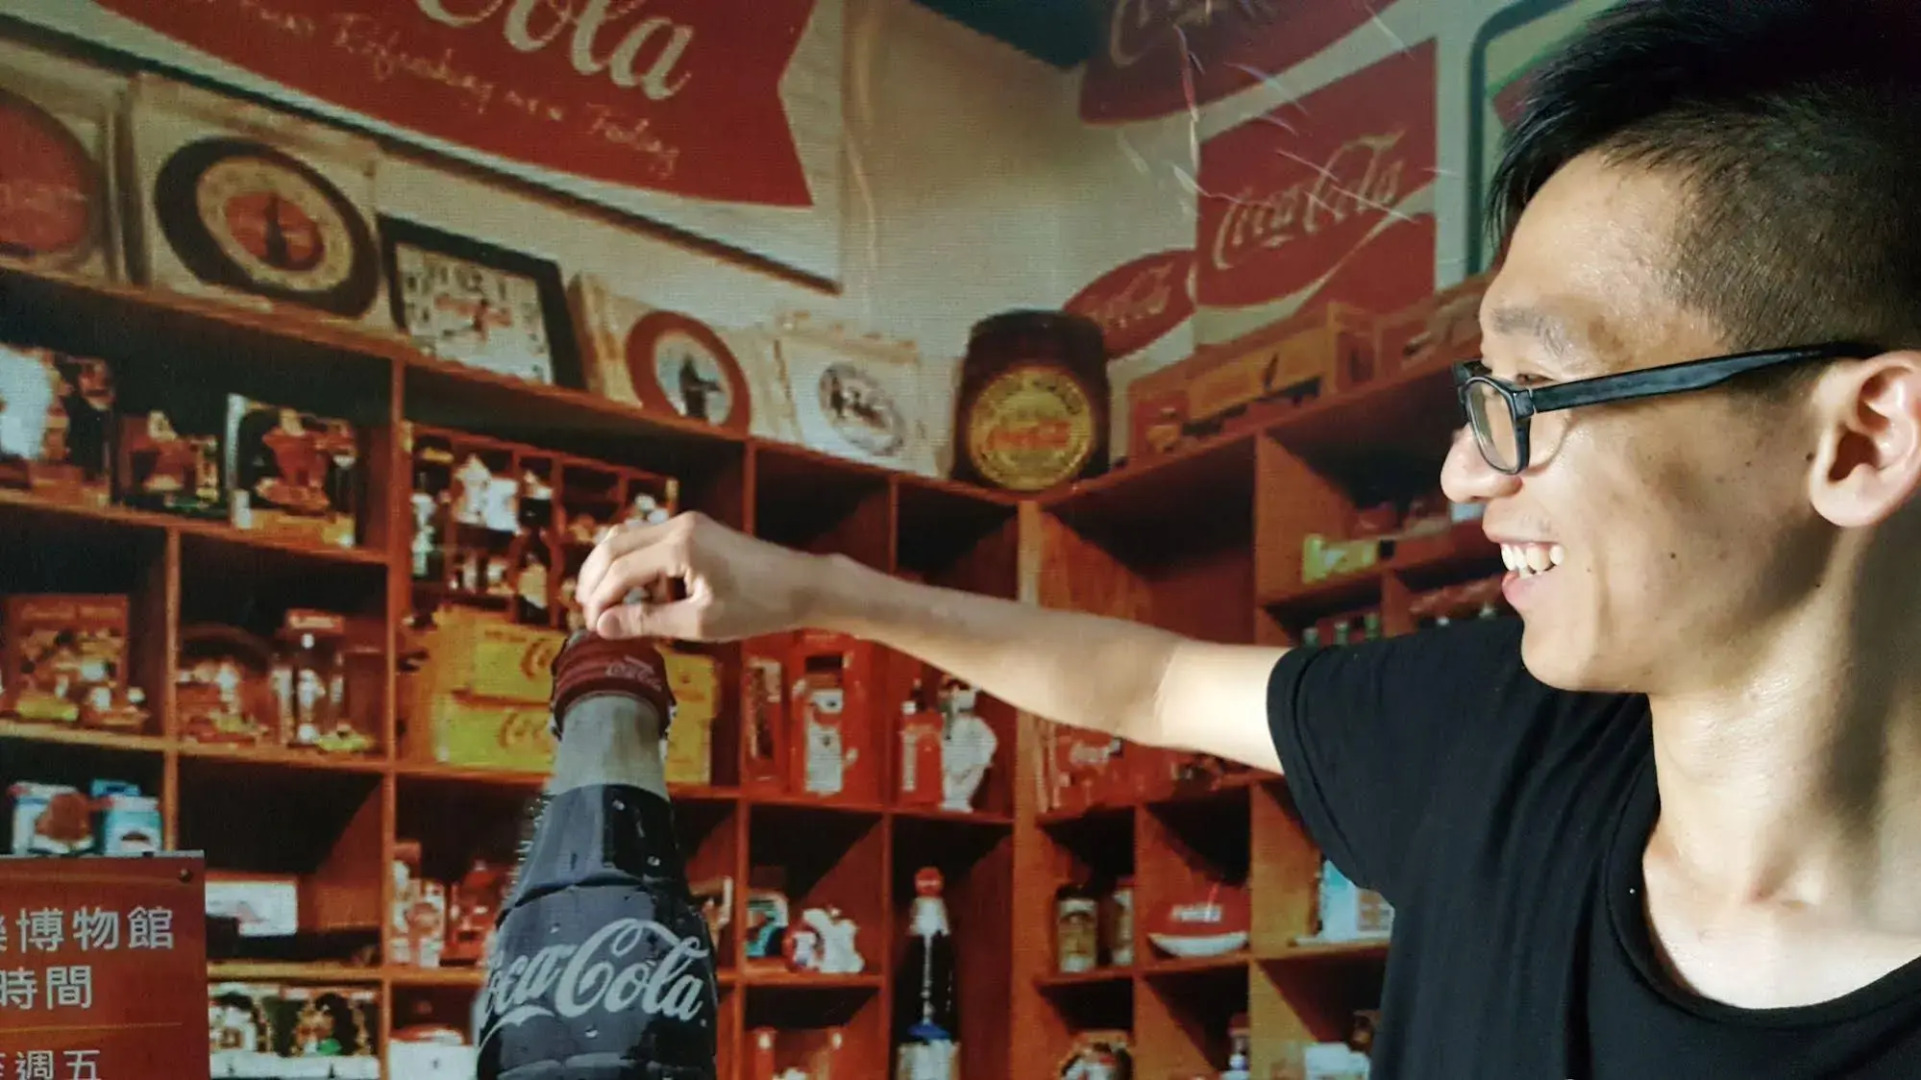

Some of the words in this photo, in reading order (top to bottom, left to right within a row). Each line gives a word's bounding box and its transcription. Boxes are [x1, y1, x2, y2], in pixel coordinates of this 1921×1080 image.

[416, 0, 693, 100] ola
[0, 906, 174, 953] 博物館
[0, 964, 93, 1010] 時間
[0, 1049, 101, 1080] 週五
